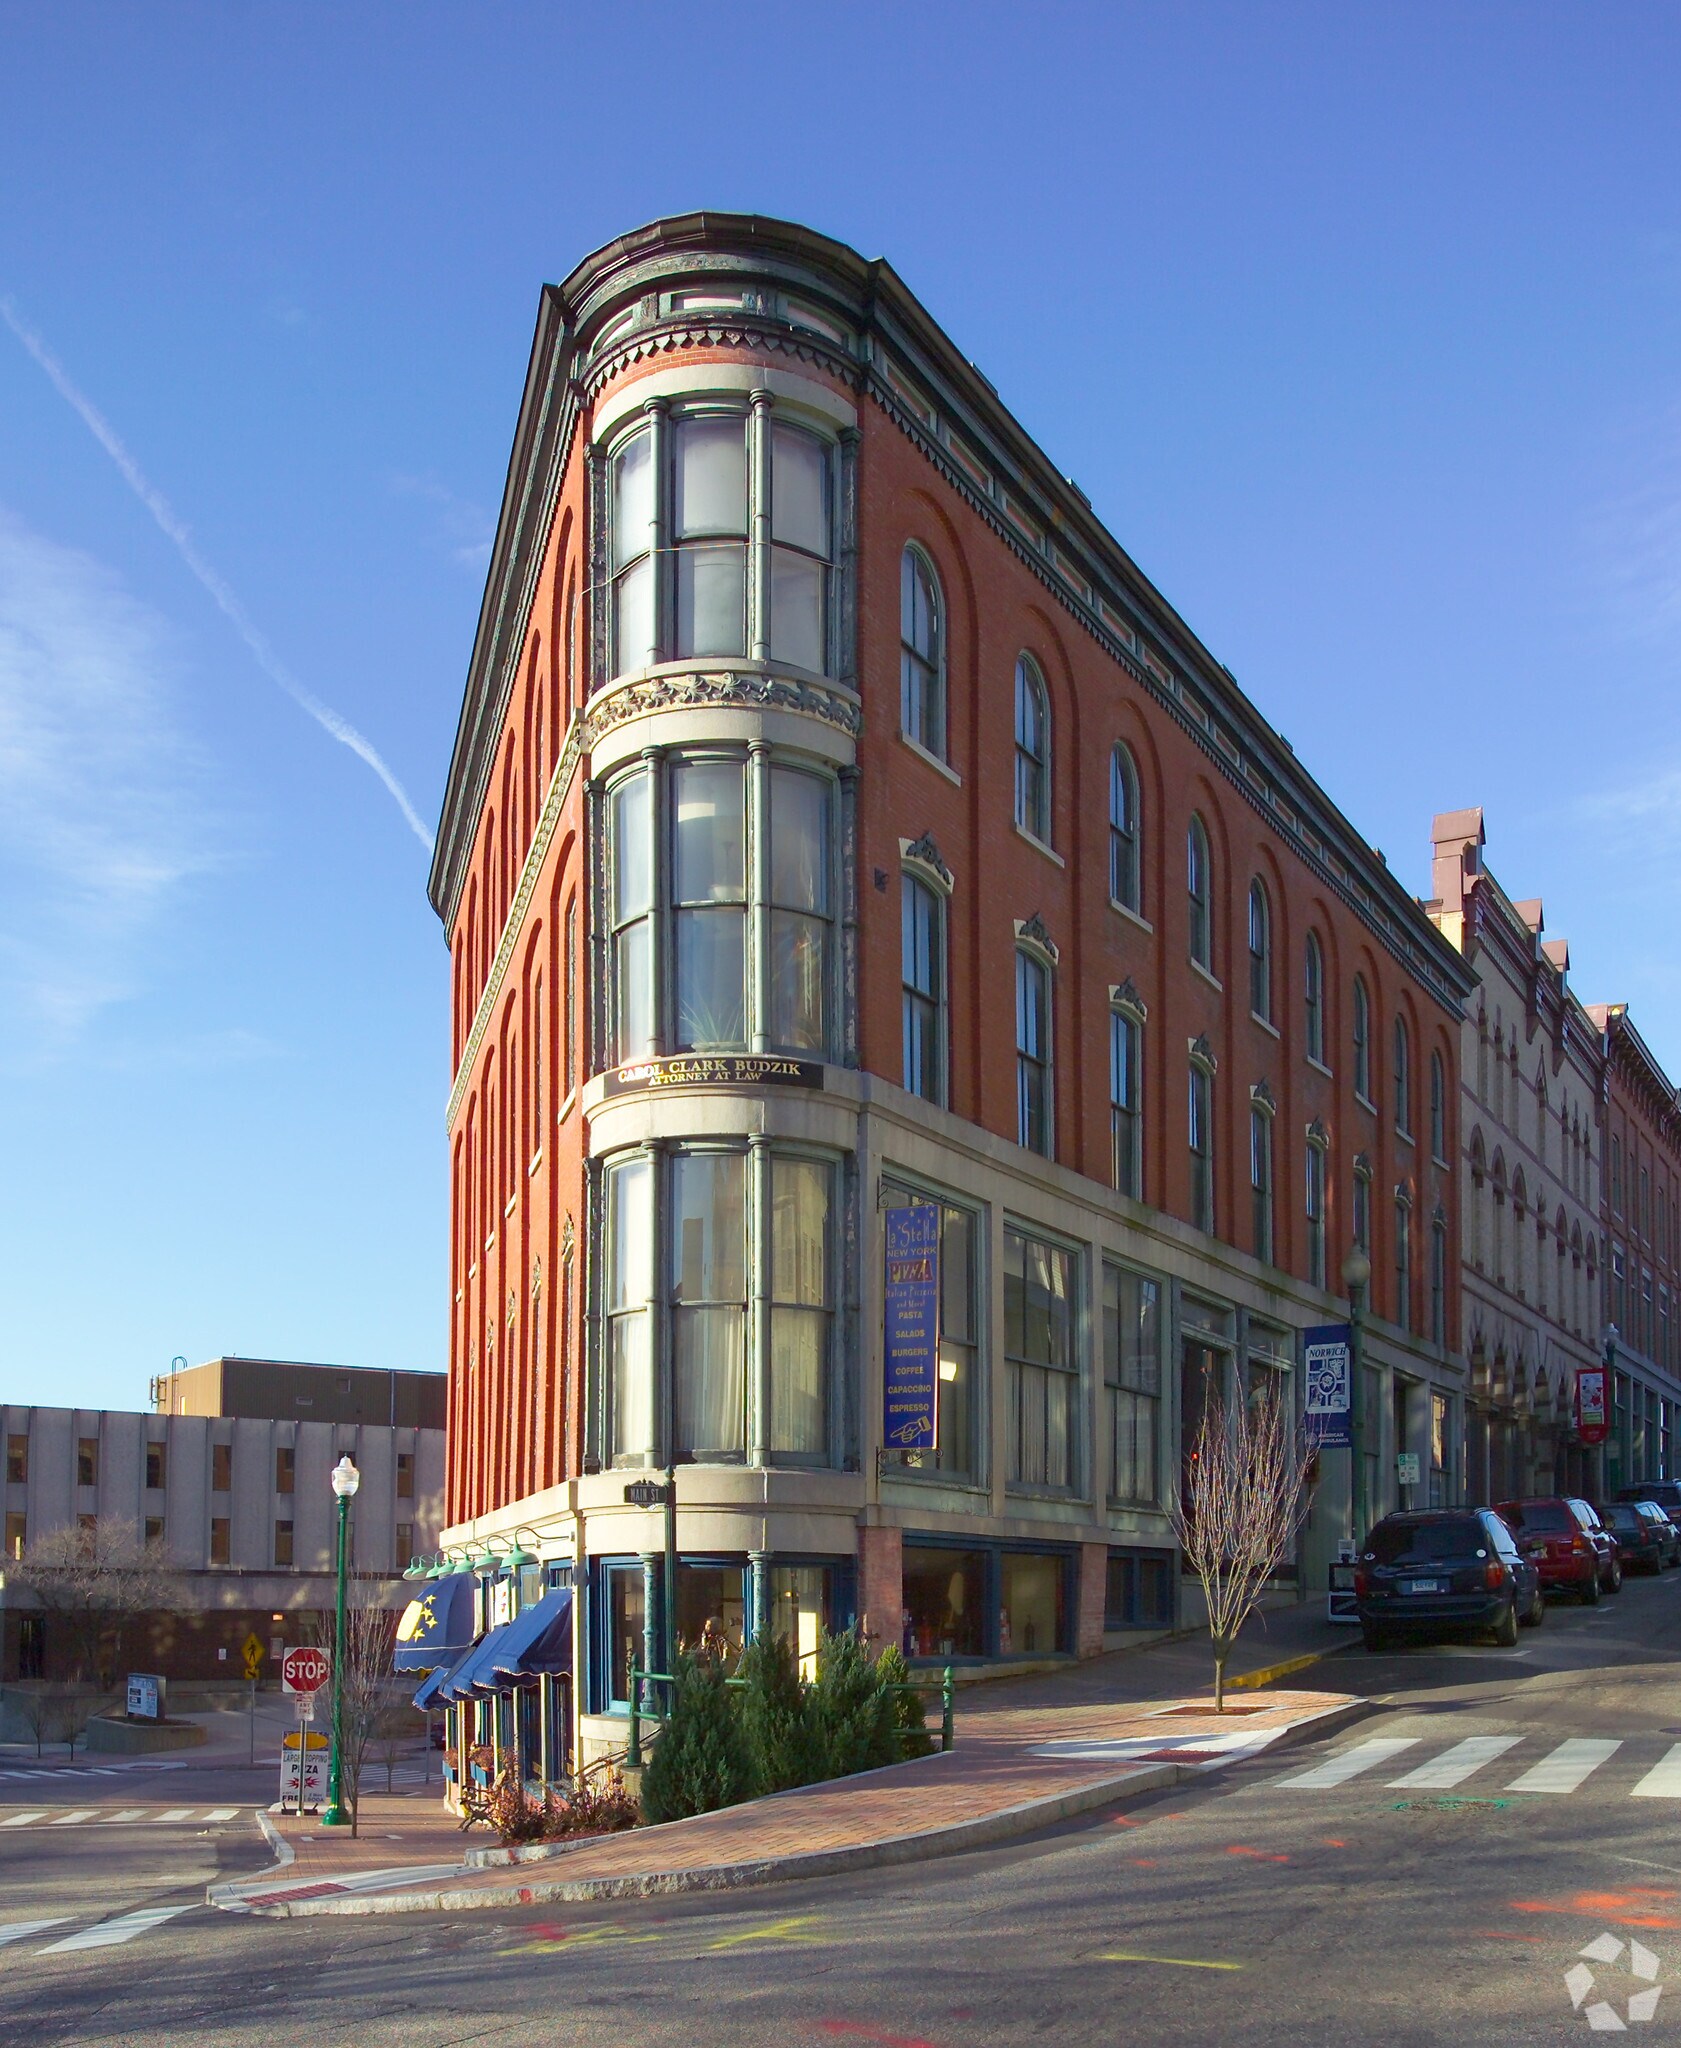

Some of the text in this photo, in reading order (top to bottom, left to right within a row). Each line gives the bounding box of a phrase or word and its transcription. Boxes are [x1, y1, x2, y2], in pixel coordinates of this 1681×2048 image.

[618, 1059, 801, 1083] CAROL CLARK BUDZIK
[648, 1071, 762, 1086] ATTORNEY AT LAW
[887, 1246, 937, 1257] NEW YORK
[898, 1311, 923, 1320] PASTA
[895, 1329, 926, 1339] SALADS
[891, 1347, 929, 1357] BURGERS
[1309, 1347, 1347, 1358] NORWICH
[895, 1366, 925, 1376] COFFEE
[888, 1384, 932, 1394] CAPACCINO
[889, 1403, 930, 1413] ESPRESSO
[630, 1488, 660, 1502] MAIN ST
[285, 1661, 327, 1680] STOP
[291, 1763, 319, 1774] PIZA
